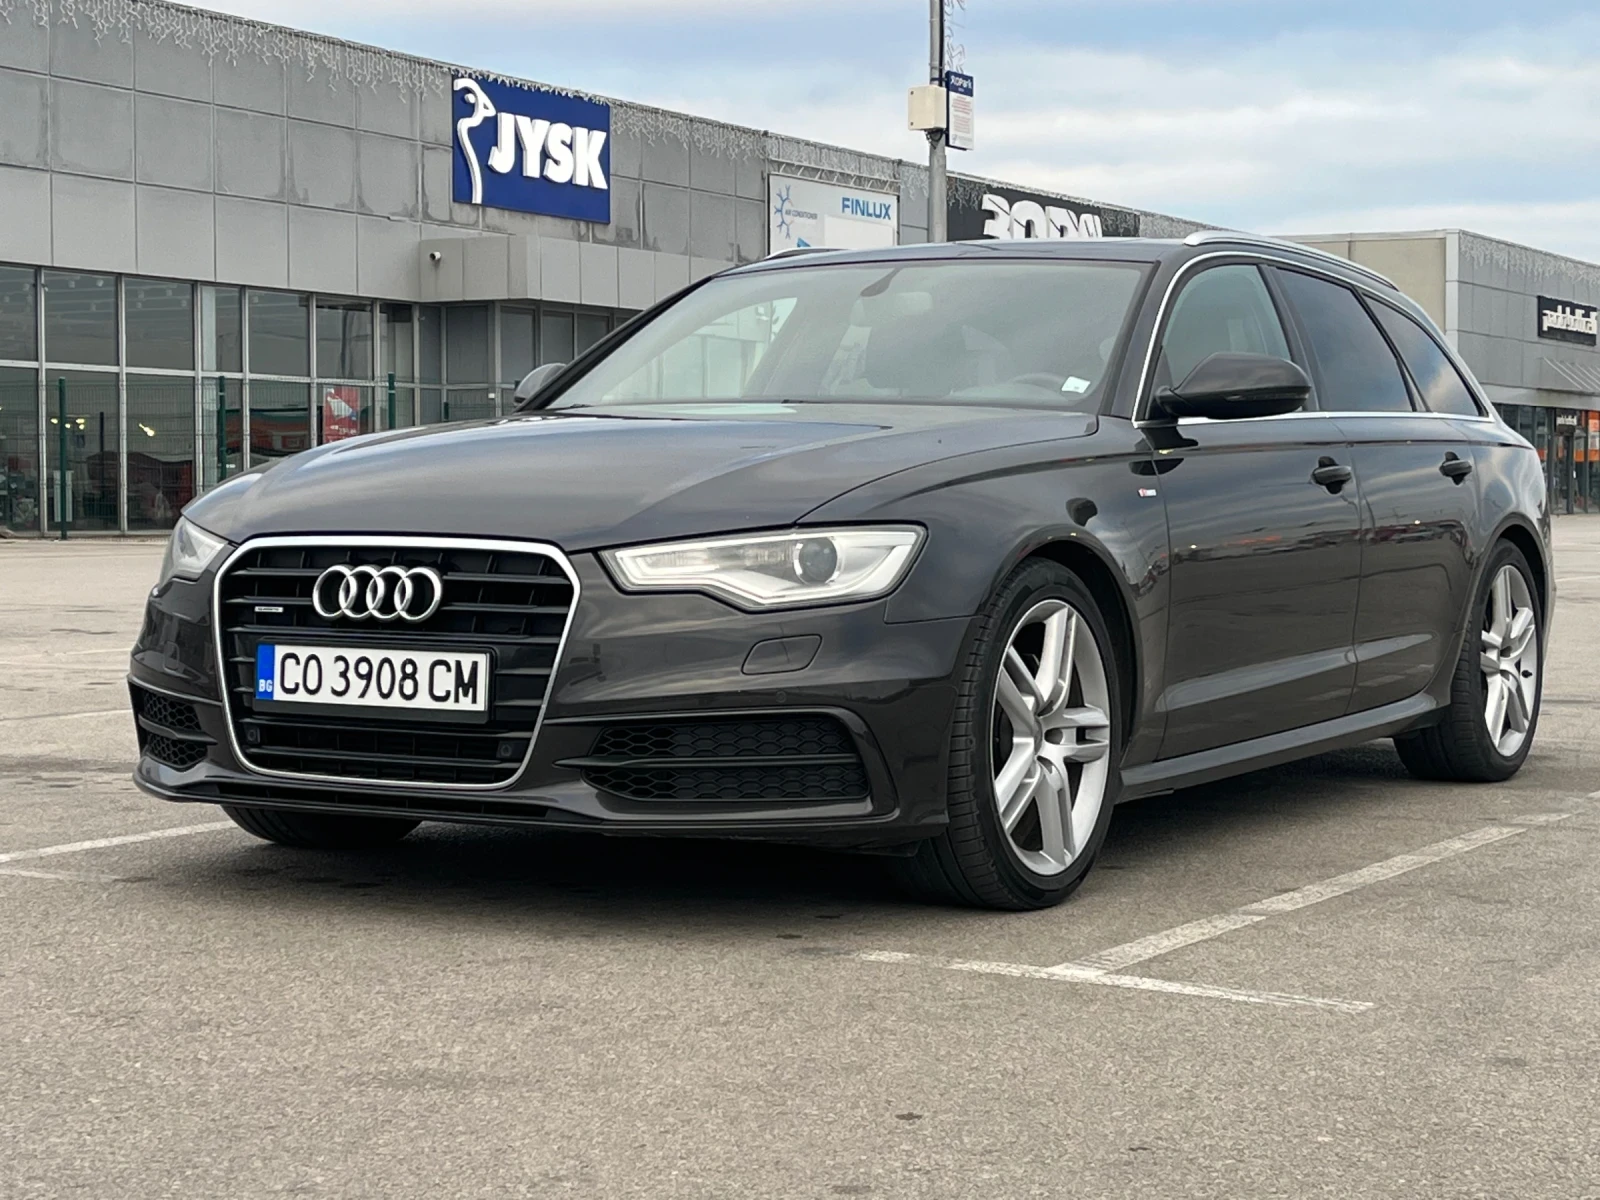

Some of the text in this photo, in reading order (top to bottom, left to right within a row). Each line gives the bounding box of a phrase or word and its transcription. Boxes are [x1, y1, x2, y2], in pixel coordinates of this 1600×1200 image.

[488, 112, 608, 189] JYSK
[841, 196, 891, 220] FINLUX
[258, 679, 273, 693] BG
[330, 654, 419, 701] 3908
[427, 658, 479, 704] CM
